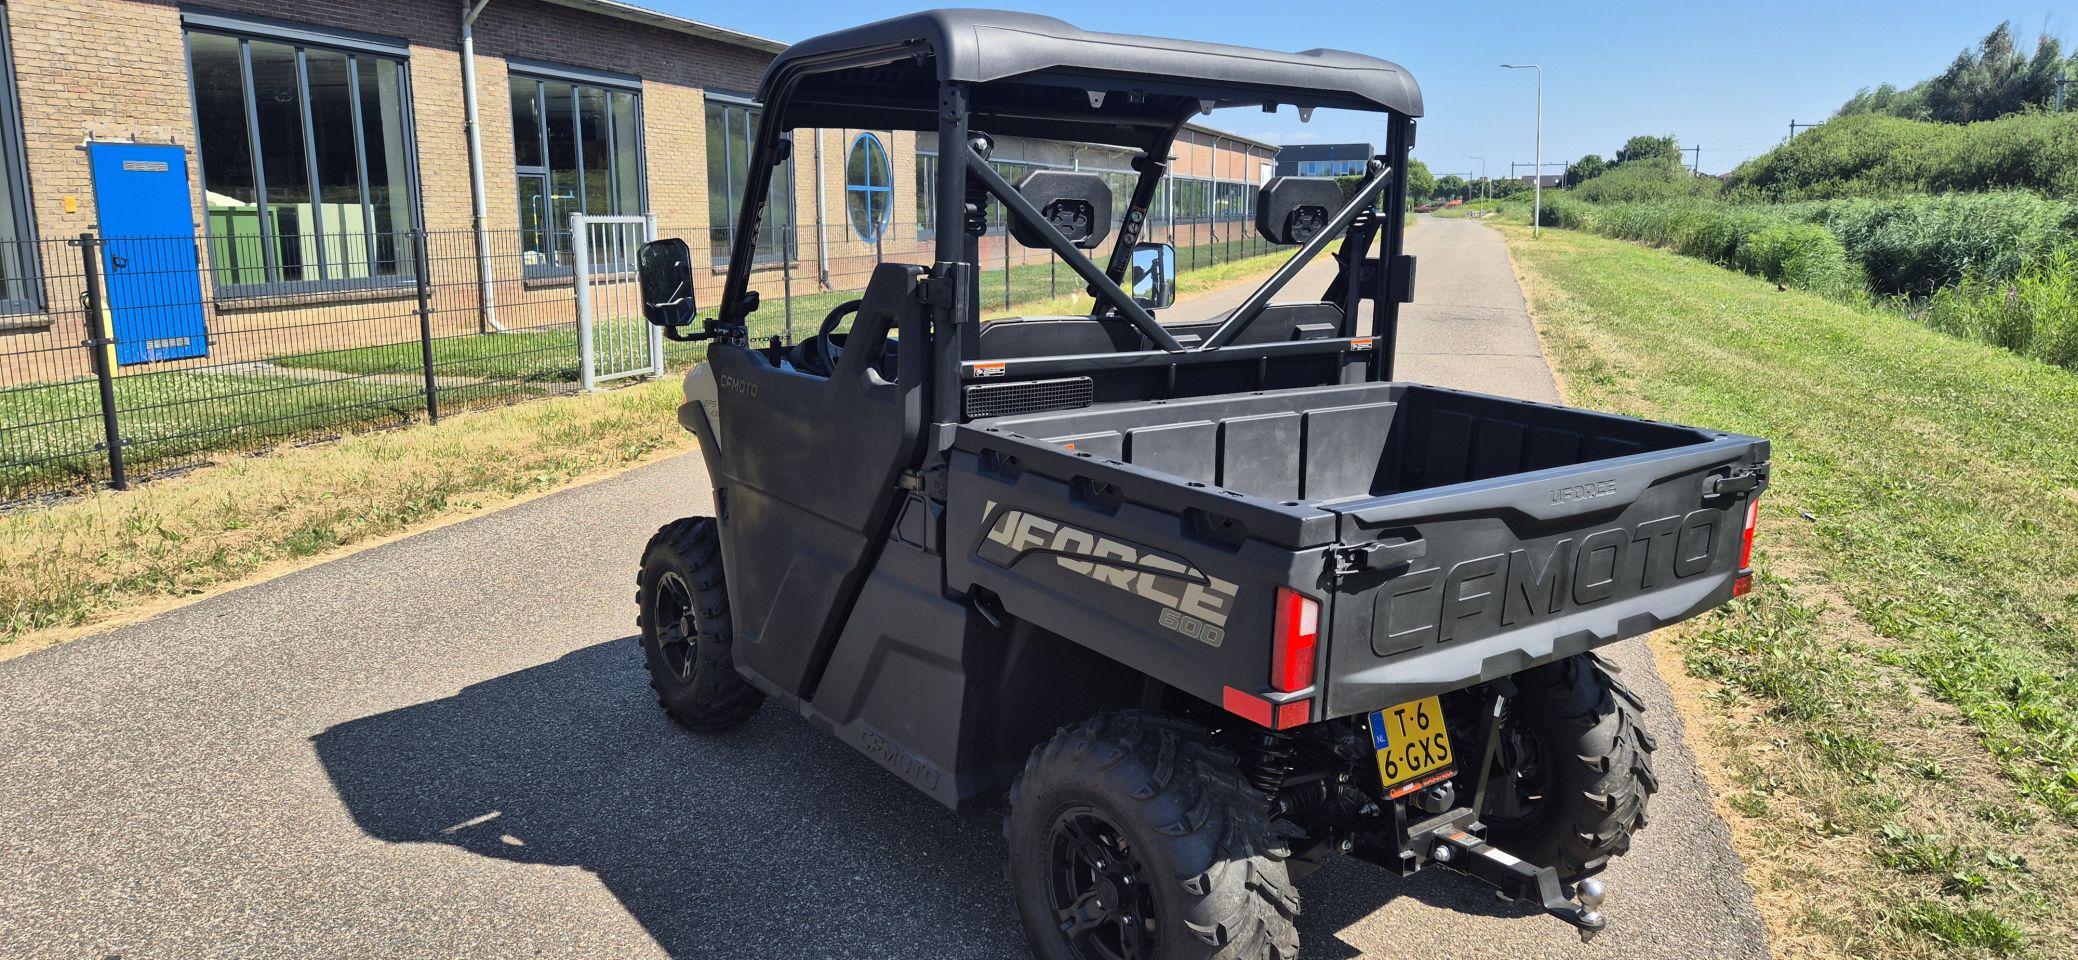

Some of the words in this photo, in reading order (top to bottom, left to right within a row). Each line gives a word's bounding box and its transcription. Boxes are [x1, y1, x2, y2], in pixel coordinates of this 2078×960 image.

[720, 374, 759, 398] CFMOTO
[1550, 479, 1616, 506] UFORCE
[981, 500, 1240, 628] UFORCE
[1371, 508, 1721, 657] CFMOTO
[1158, 607, 1226, 648] 600
[1376, 735, 1386, 744] NL
